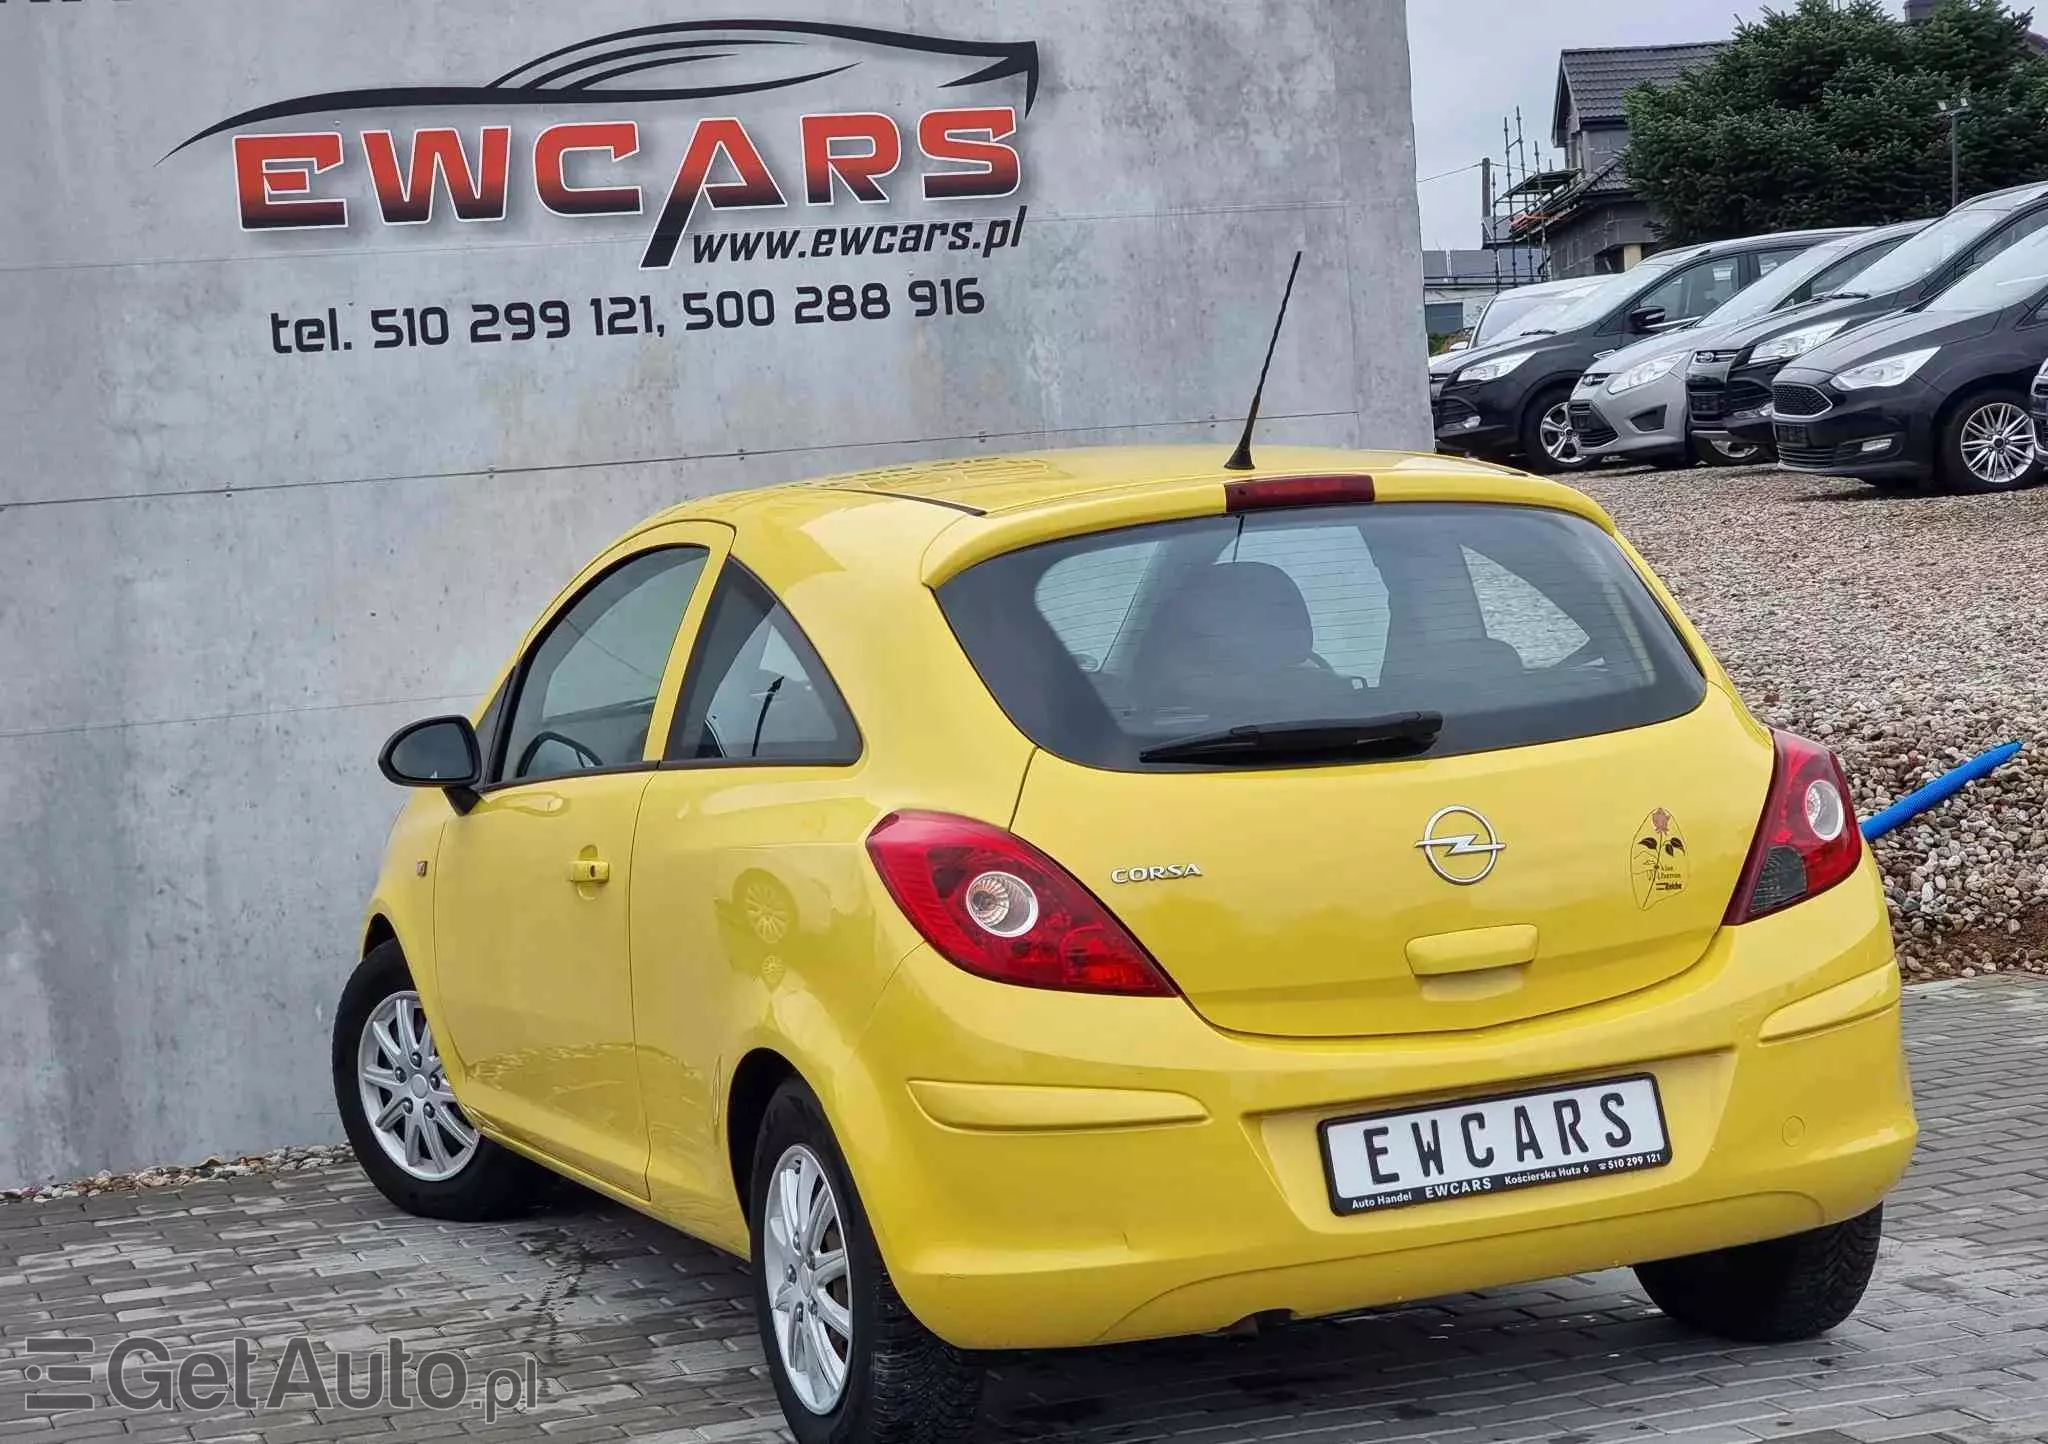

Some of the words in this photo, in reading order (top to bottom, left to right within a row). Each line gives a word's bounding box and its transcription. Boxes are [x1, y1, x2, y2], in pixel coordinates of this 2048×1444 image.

[232, 107, 1022, 270] EWCARS
[693, 205, 1028, 264] www.ewcars.pl
[270, 307, 353, 354] tel.
[370, 306, 450, 349] 510
[469, 299, 571, 344] 299
[590, 295, 665, 338] 121,
[682, 288, 775, 331] 500
[794, 282, 891, 325] 288
[907, 277, 986, 317] 916
[1110, 862, 1203, 884] CORSA
[1363, 1092, 1632, 1186] EWCARS
[1352, 1199, 1376, 1209] Auto
[1377, 1191, 1413, 1205] Handel
[1424, 1177, 1492, 1199] EWCARS
[1504, 1168, 1557, 1185] Kościerska
[1558, 1165, 1581, 1177] Huta
[1583, 1164, 1589, 1174] 6
[1607, 1158, 1624, 1170] 510
[1627, 1155, 1644, 1168] 299
[1646, 1152, 1661, 1163] 121
